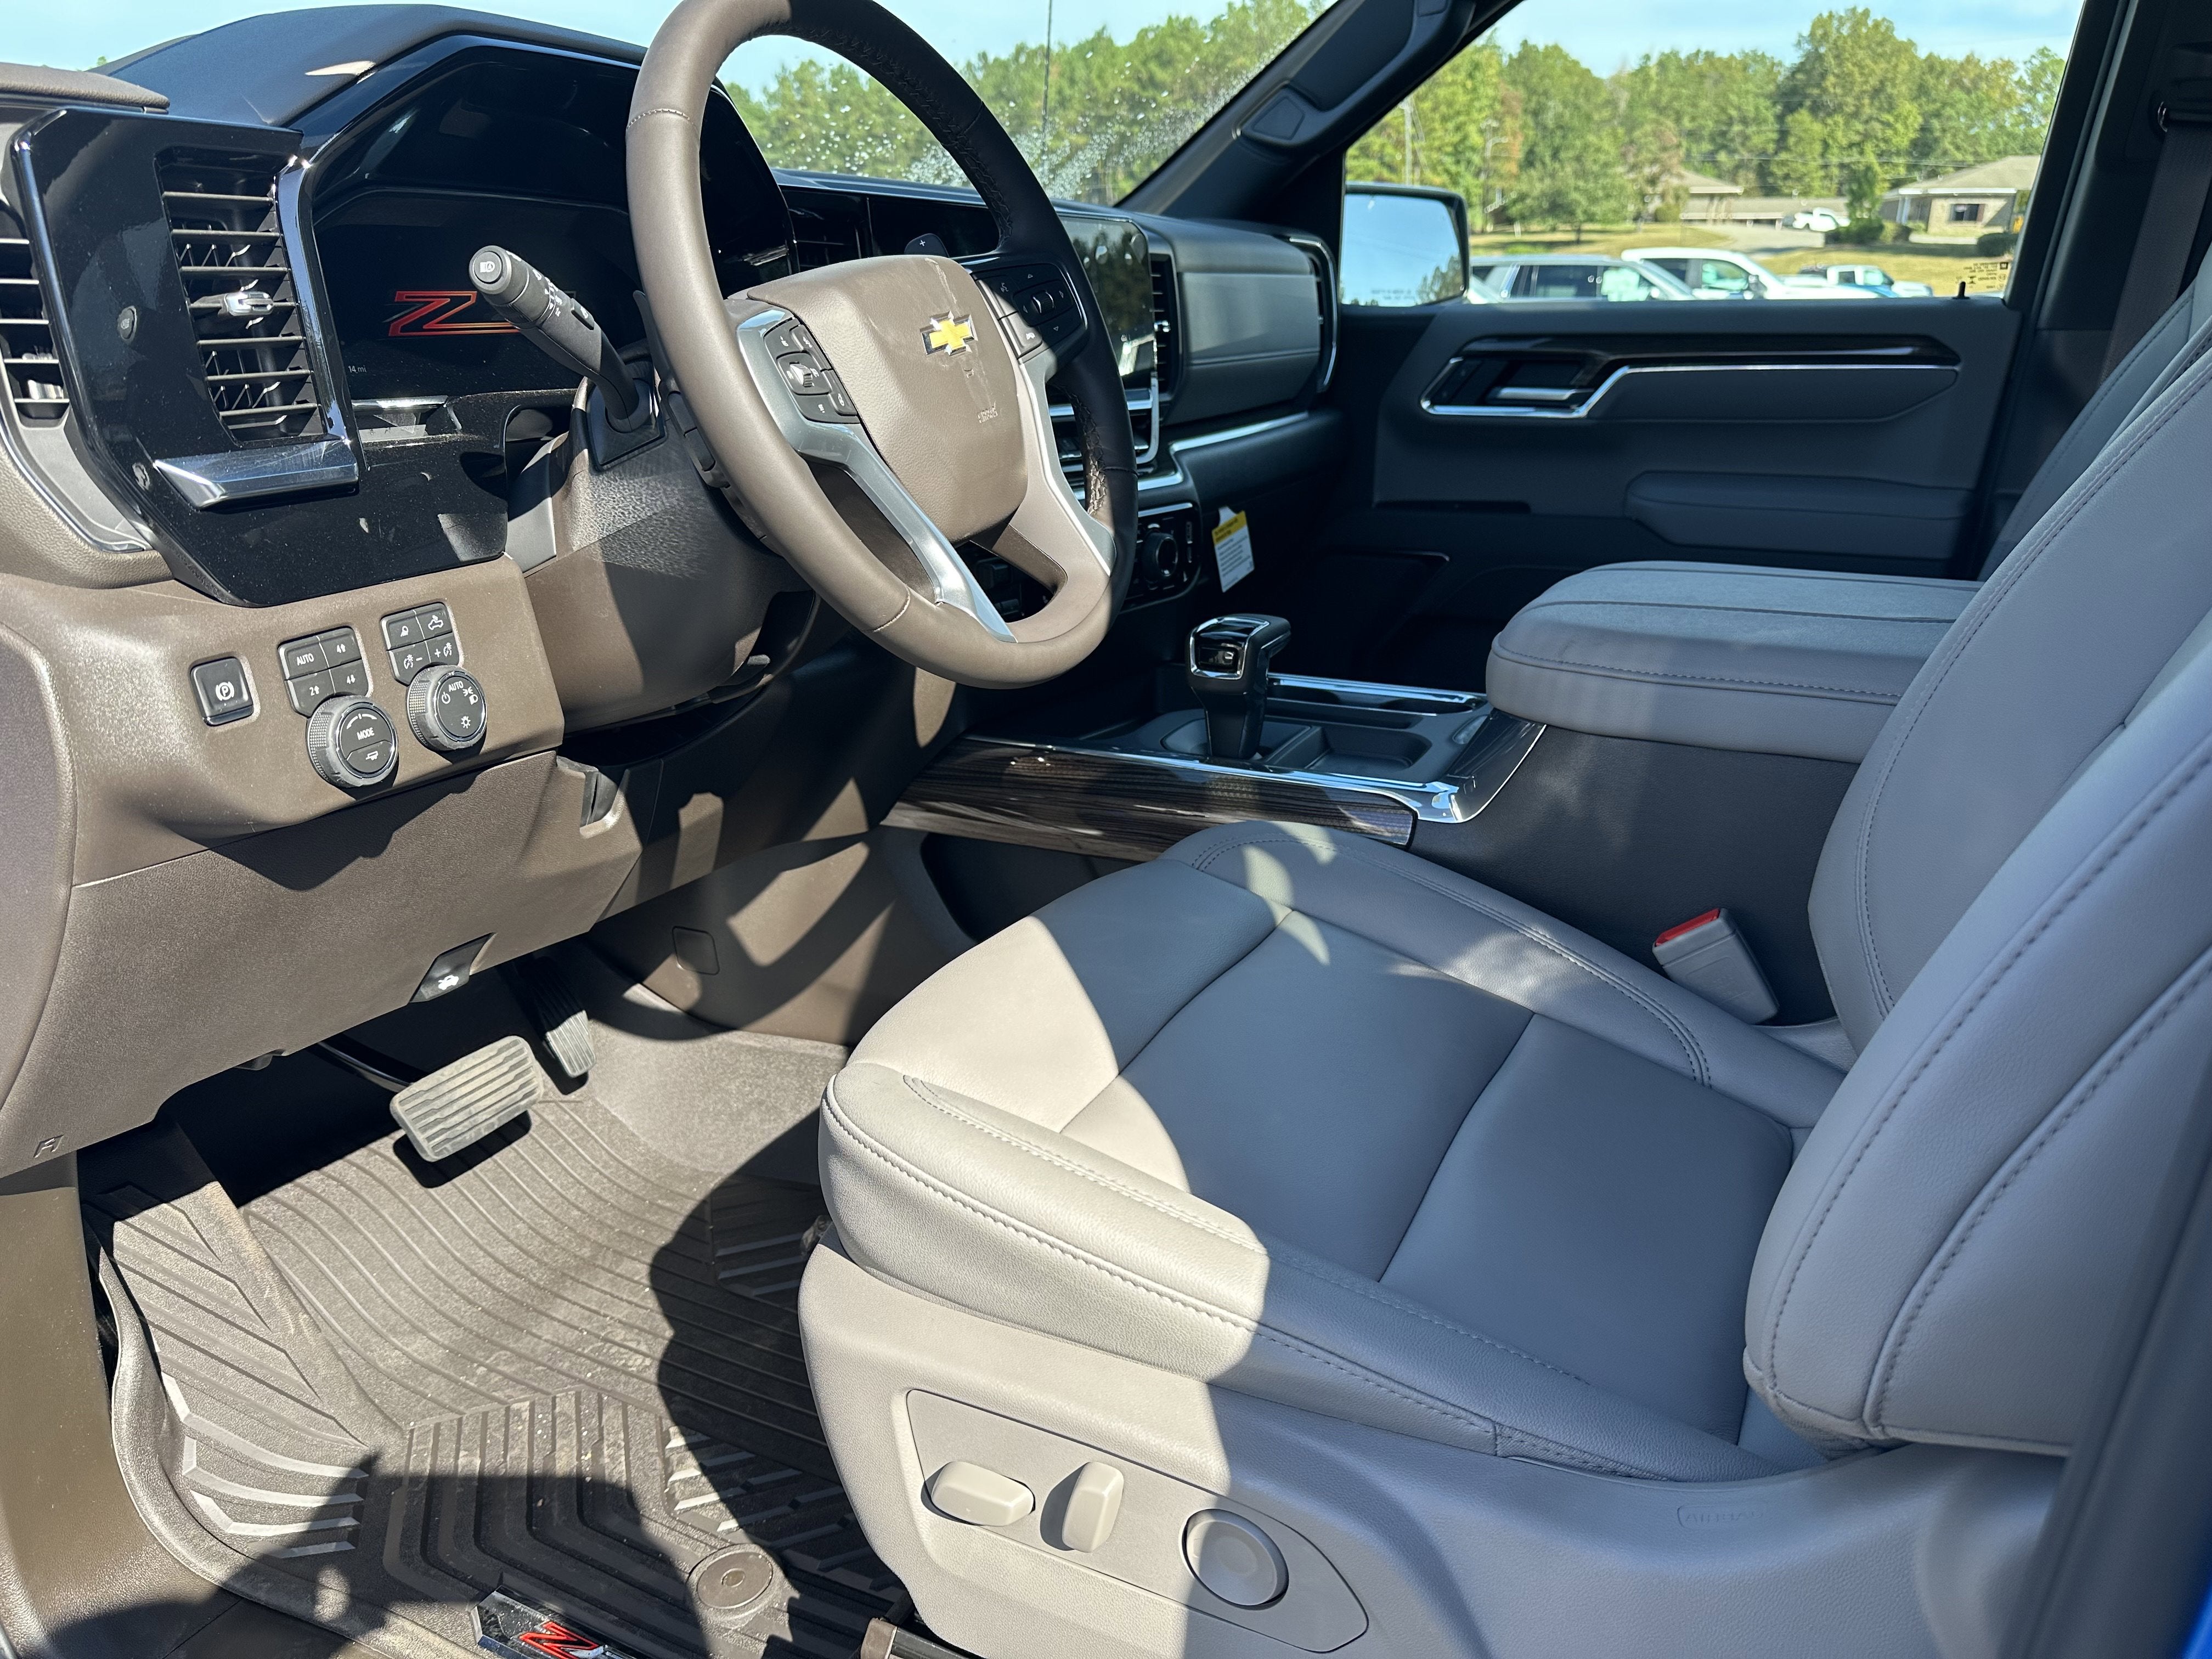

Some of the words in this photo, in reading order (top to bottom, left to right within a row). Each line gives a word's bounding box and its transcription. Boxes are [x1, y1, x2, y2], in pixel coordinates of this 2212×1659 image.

[357, 364, 368, 373] mi
[296, 653, 314, 665] AUTO
[448, 680, 464, 692] AUTO
[357, 727, 375, 741] MODE
